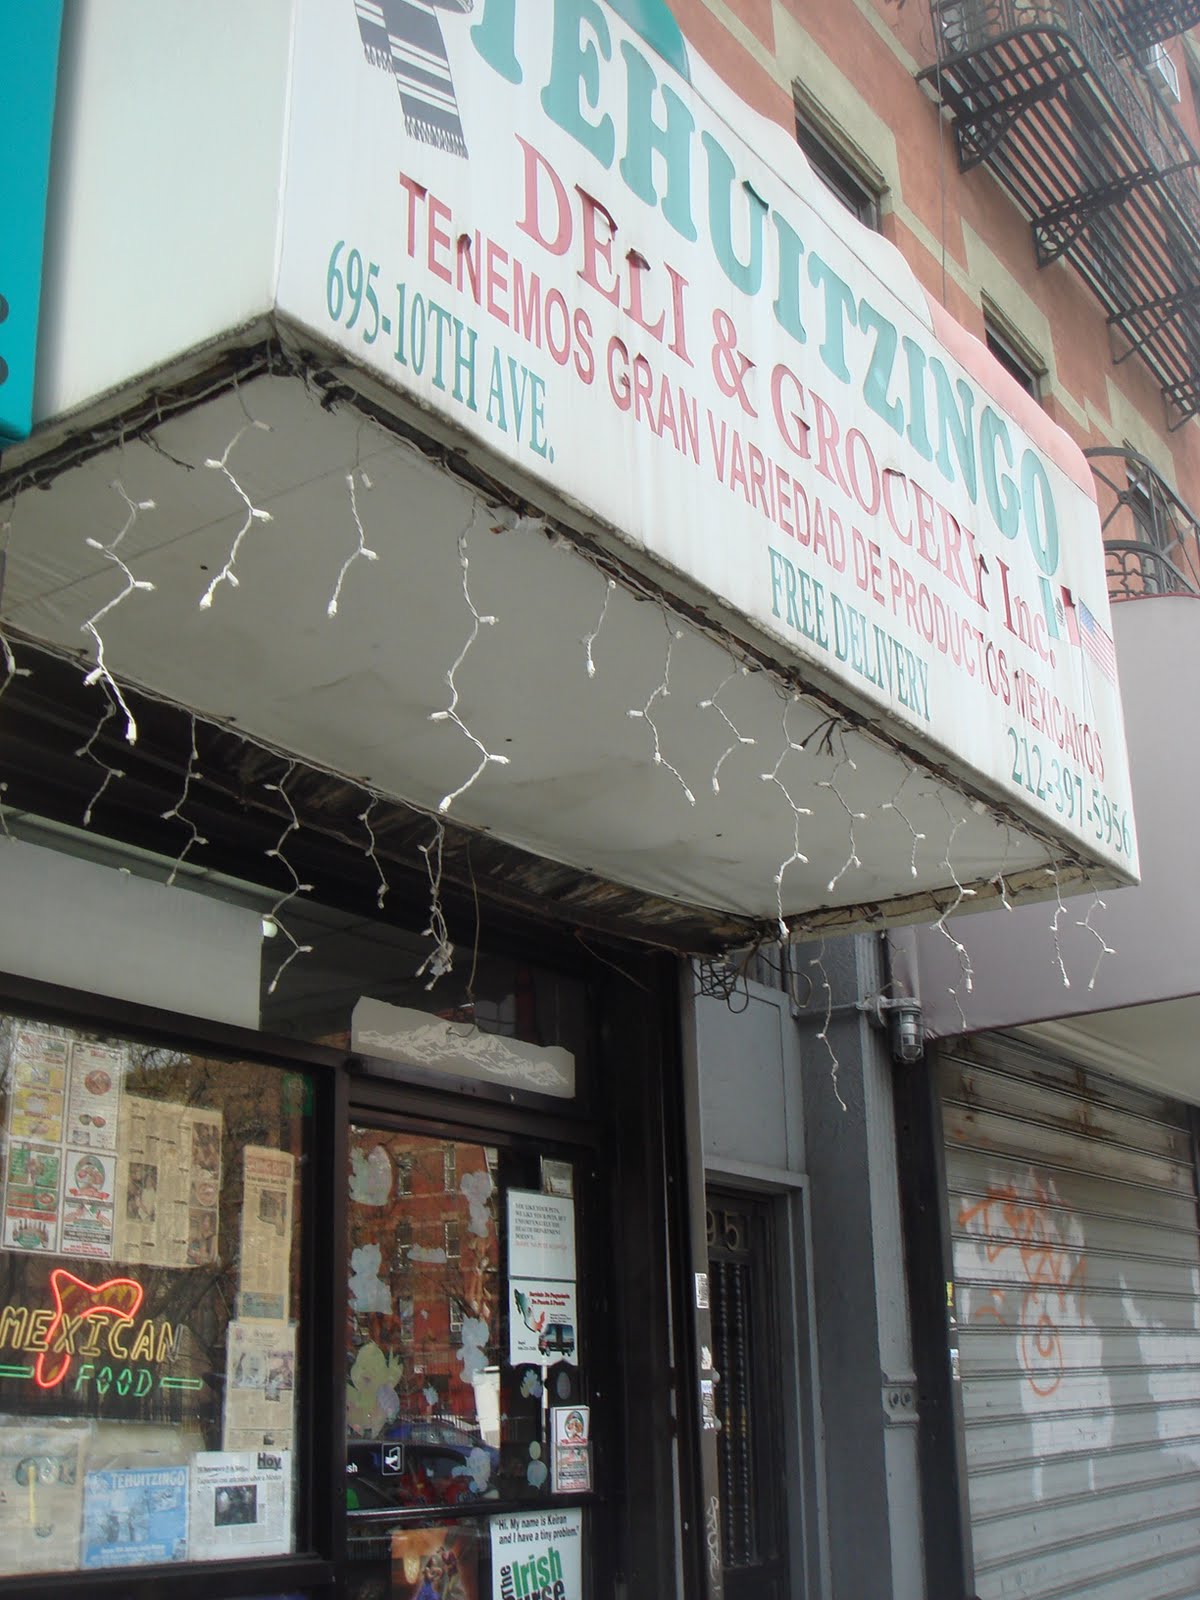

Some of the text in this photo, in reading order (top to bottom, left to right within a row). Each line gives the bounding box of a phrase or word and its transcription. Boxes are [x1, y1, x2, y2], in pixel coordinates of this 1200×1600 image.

[326, 239, 555, 464] 695-10TH AVE.
[514, 132, 1056, 669] DELI & GROCERY Inc.
[399, 171, 1104, 783] TENEMOS GRAN VARIEDAD DE PRODUCTOS MEXICANOS
[768, 545, 931, 722] FREE DELIVERY
[1007, 726, 1133, 859] 212-397-5956
[0, 1305, 185, 1363] MEXICAN
[73, 1364, 153, 1397] FOOD
[257, 1452, 282, 1471] Hoy
[499, 1532, 512, 1545] and
[518, 1530, 533, 1543] have
[540, 1528, 552, 1541] tiny
[510, 1517, 520, 1531] My
[521, 1518, 539, 1529] name
[541, 1515, 546, 1526] is
[511, 1546, 563, 1598] Irish
